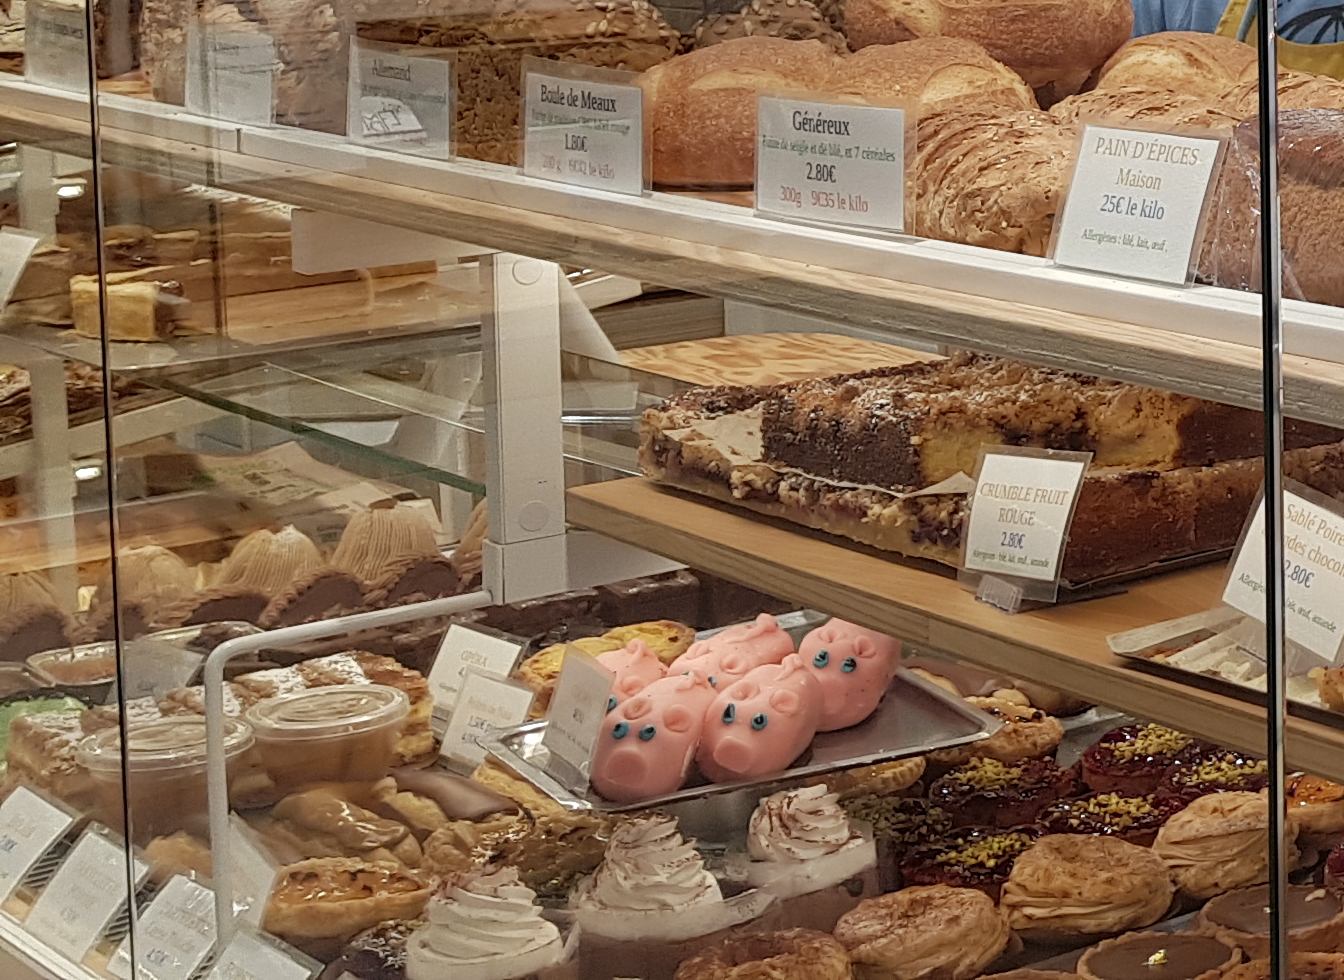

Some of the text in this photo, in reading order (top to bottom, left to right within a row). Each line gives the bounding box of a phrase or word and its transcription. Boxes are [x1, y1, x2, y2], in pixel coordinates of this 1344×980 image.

[540, 84, 618, 113] Boule de Meaux
[792, 110, 851, 137] Généreux
[1094, 136, 1200, 166] PAIN D'ÉPICES
[805, 162, 837, 183] 2.80€
[1115, 167, 1162, 191] Maison
[836, 192, 846, 210] le
[849, 194, 869, 213] kilo
[1099, 194, 1165, 220] 25€ le kilo
[980, 482, 1070, 506] CRUMBLE FRUIT
[997, 507, 1036, 526] ROUGE
[1285, 503, 1317, 531] Sablé
[1001, 531, 1026, 549] 2.80€
[1284, 559, 1315, 588] 2.80€
